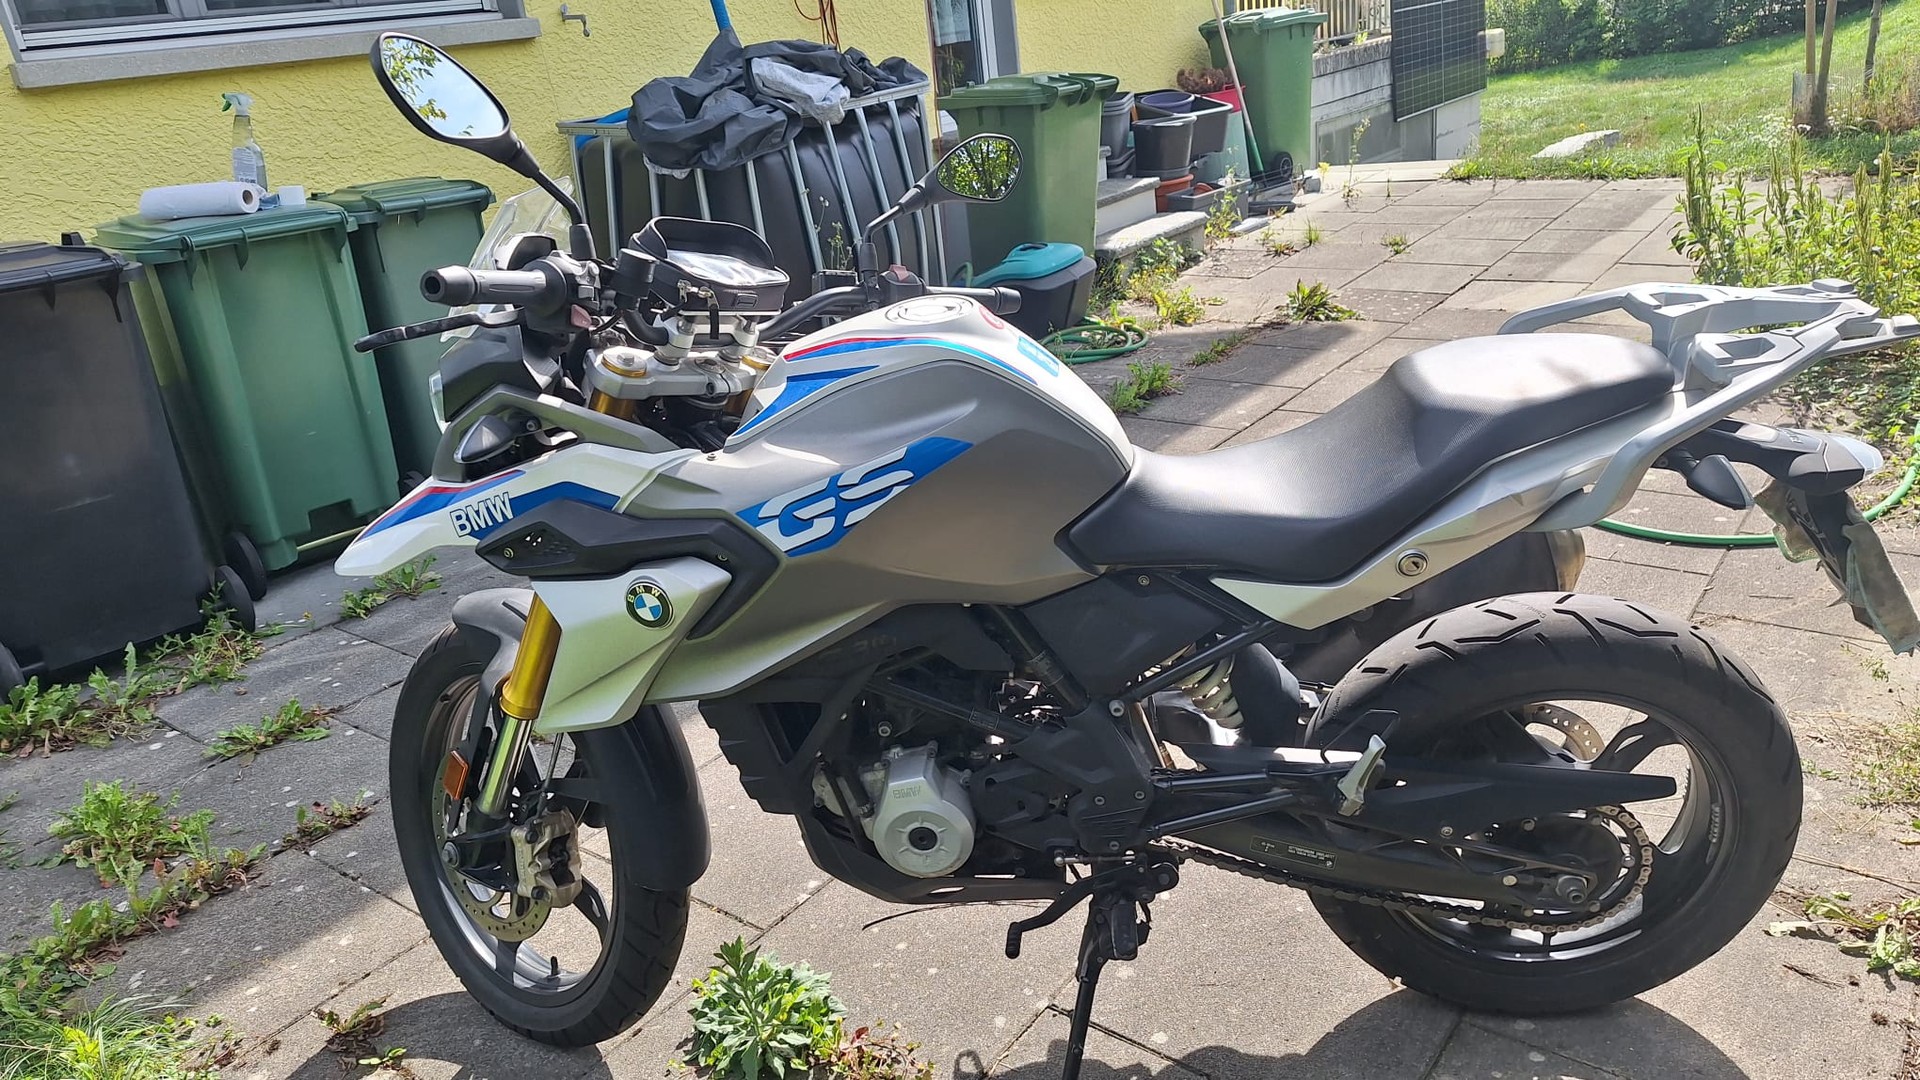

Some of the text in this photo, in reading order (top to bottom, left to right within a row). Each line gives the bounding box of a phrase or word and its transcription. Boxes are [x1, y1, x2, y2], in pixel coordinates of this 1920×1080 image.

[450, 492, 513, 537] BMW
[756, 447, 915, 552] GS
[628, 585, 661, 602] BMW
[893, 786, 920, 799] BMW
